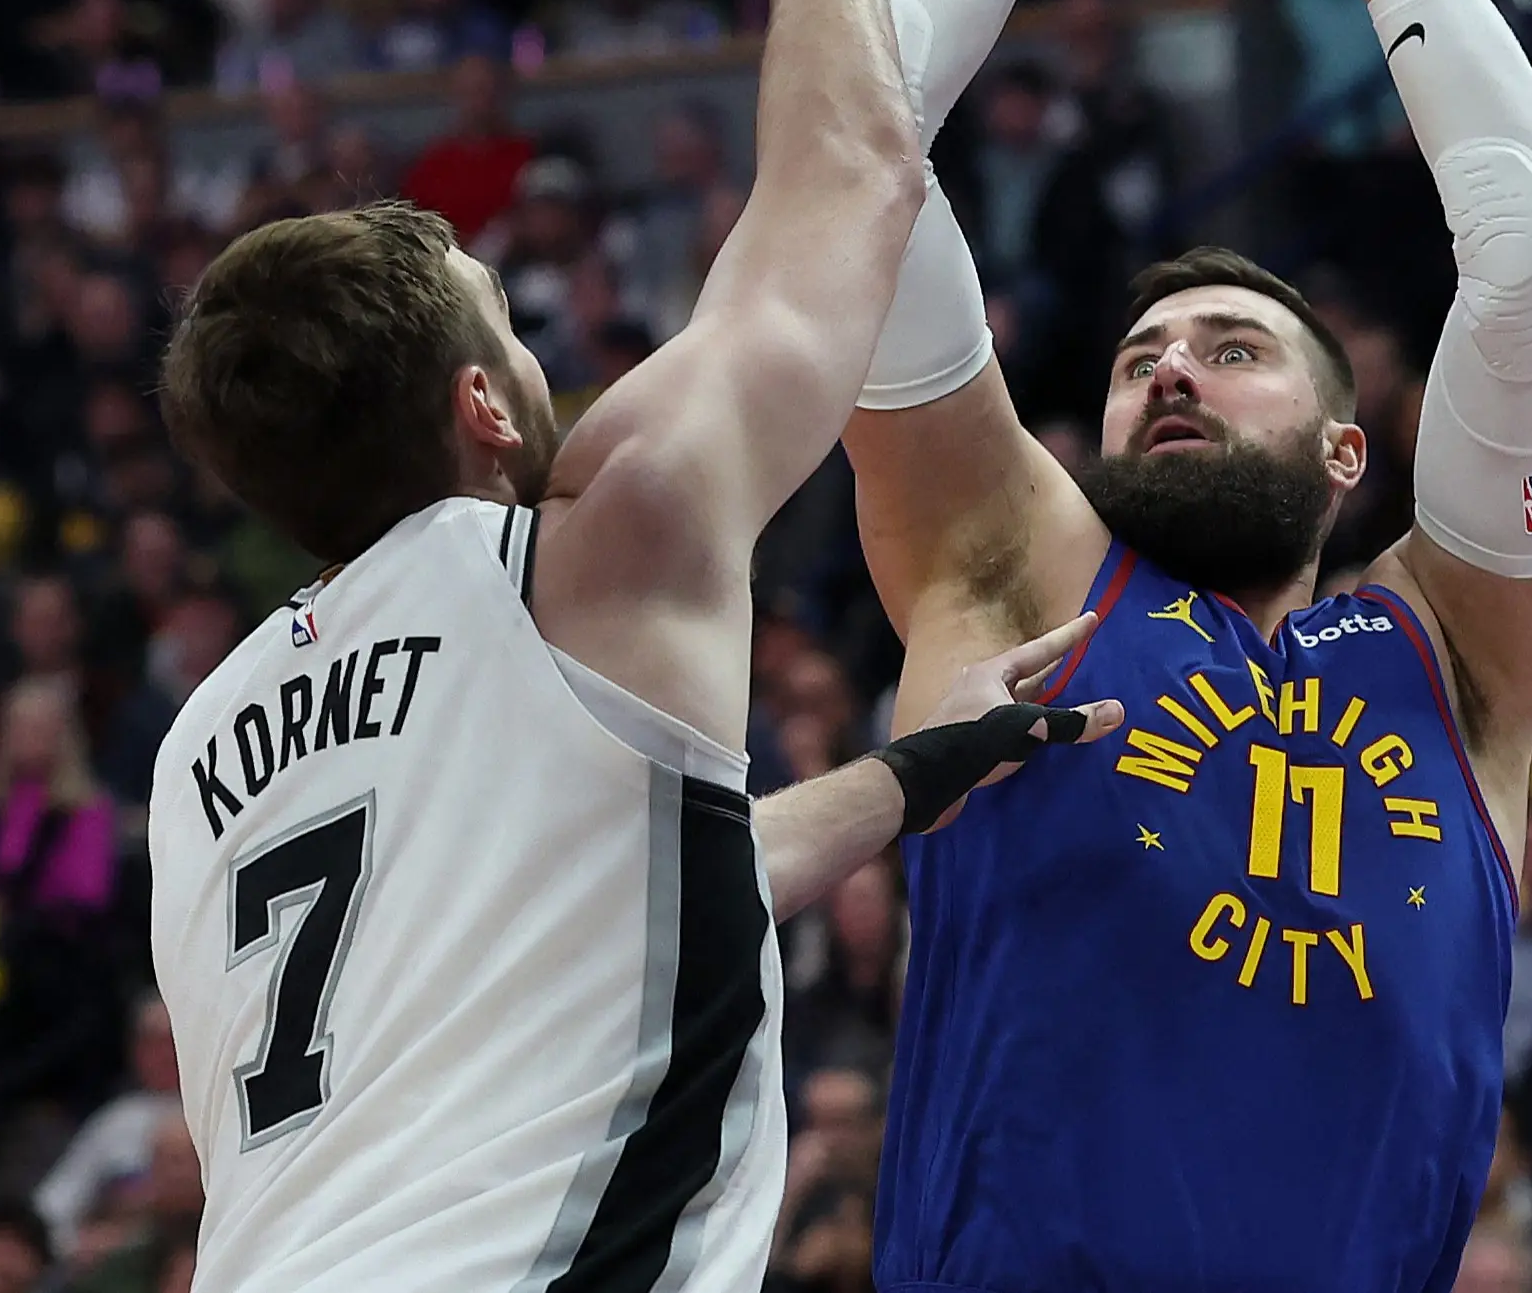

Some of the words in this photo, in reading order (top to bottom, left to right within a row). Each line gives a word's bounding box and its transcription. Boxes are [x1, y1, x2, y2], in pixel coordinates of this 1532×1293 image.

[1295, 614, 1393, 648] botta
[191, 637, 440, 840] KORNET
[1115, 657, 1278, 793] MILE
[1278, 677, 1441, 842] HIGH
[1248, 744, 1344, 897] 11
[226, 789, 375, 1153] 7
[1189, 892, 1374, 1005] CITY
